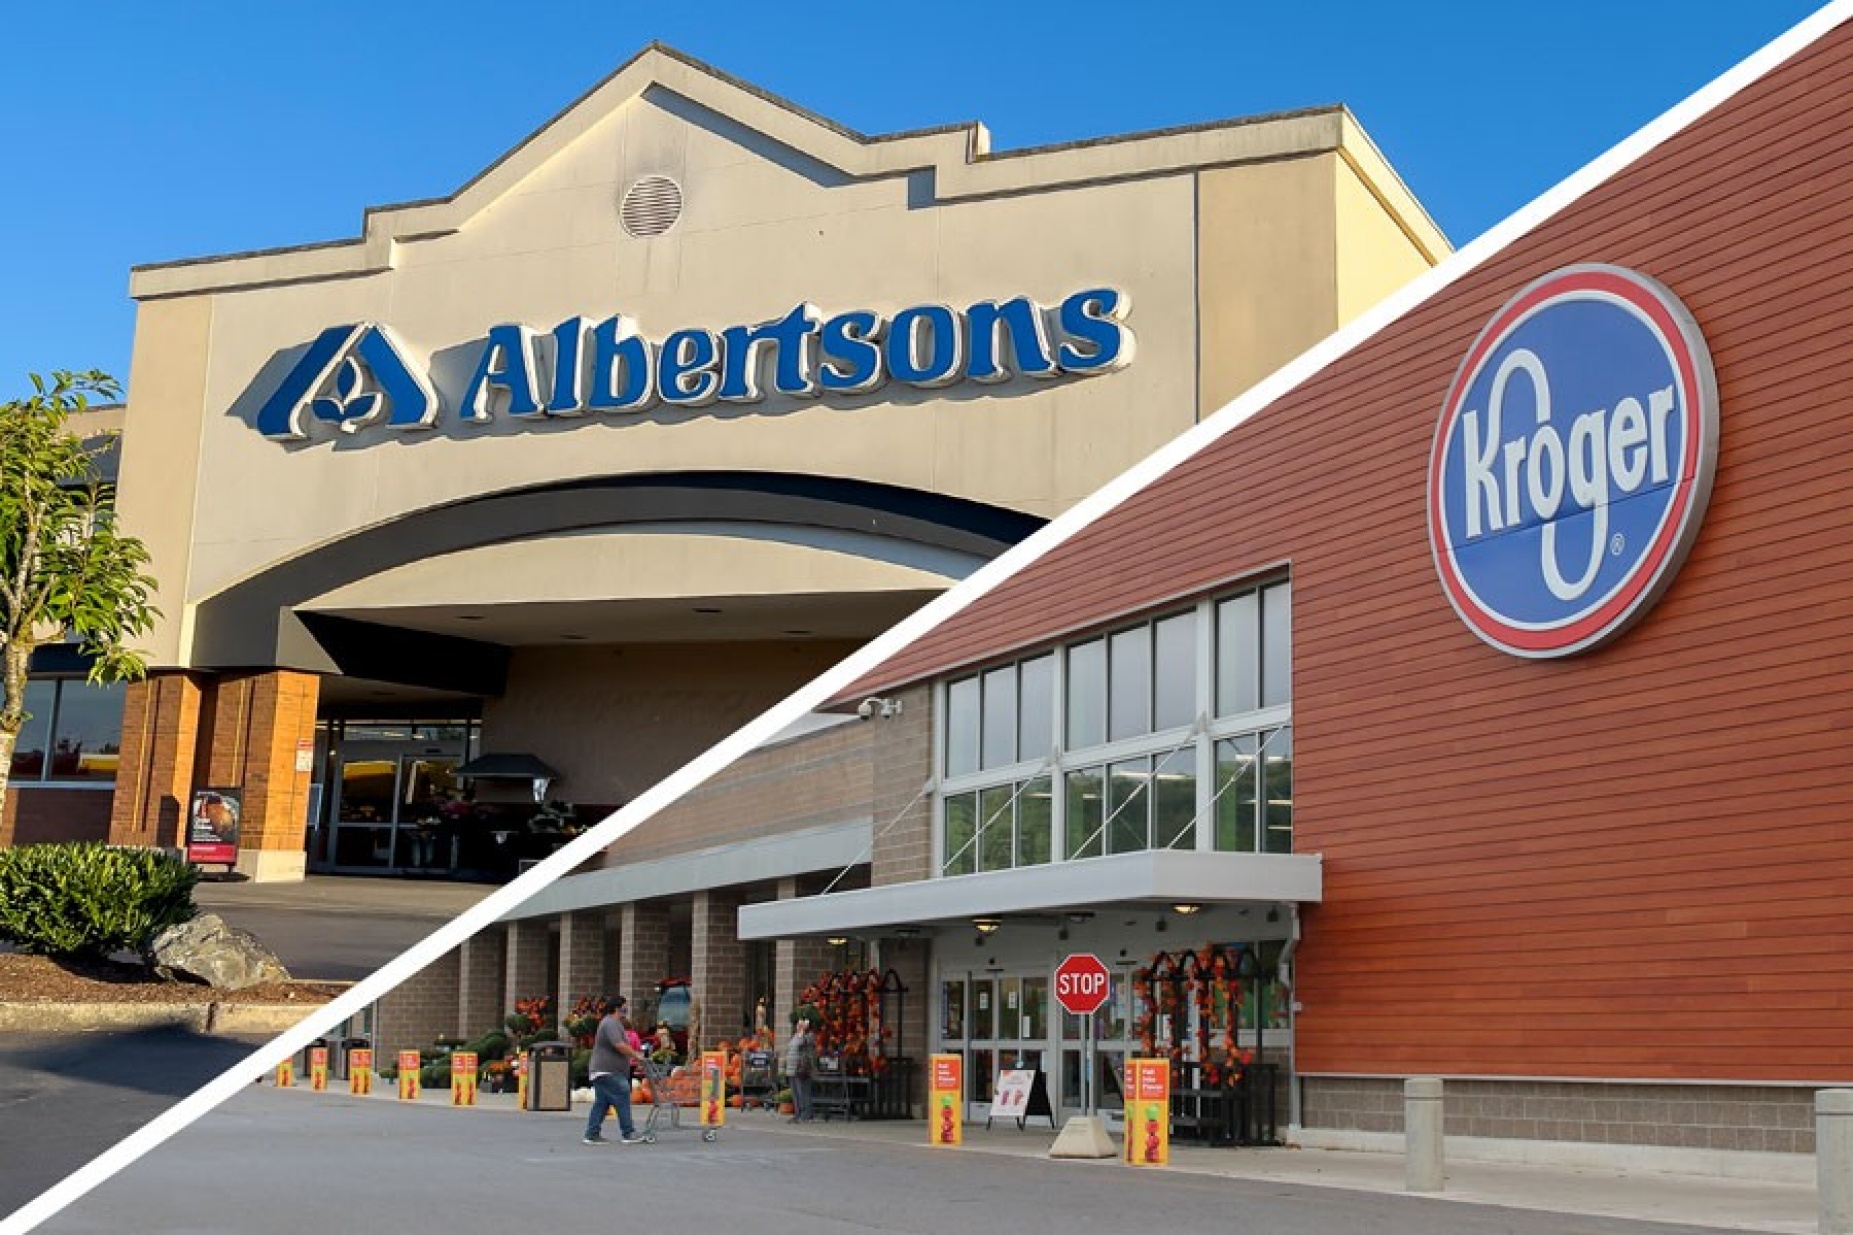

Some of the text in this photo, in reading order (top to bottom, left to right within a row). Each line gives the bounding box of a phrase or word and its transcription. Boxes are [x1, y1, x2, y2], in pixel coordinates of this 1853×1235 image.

[459, 286, 1133, 422] Albertsons
[1462, 348, 1676, 602] Kroger
[1058, 972, 1105, 995] STOP
